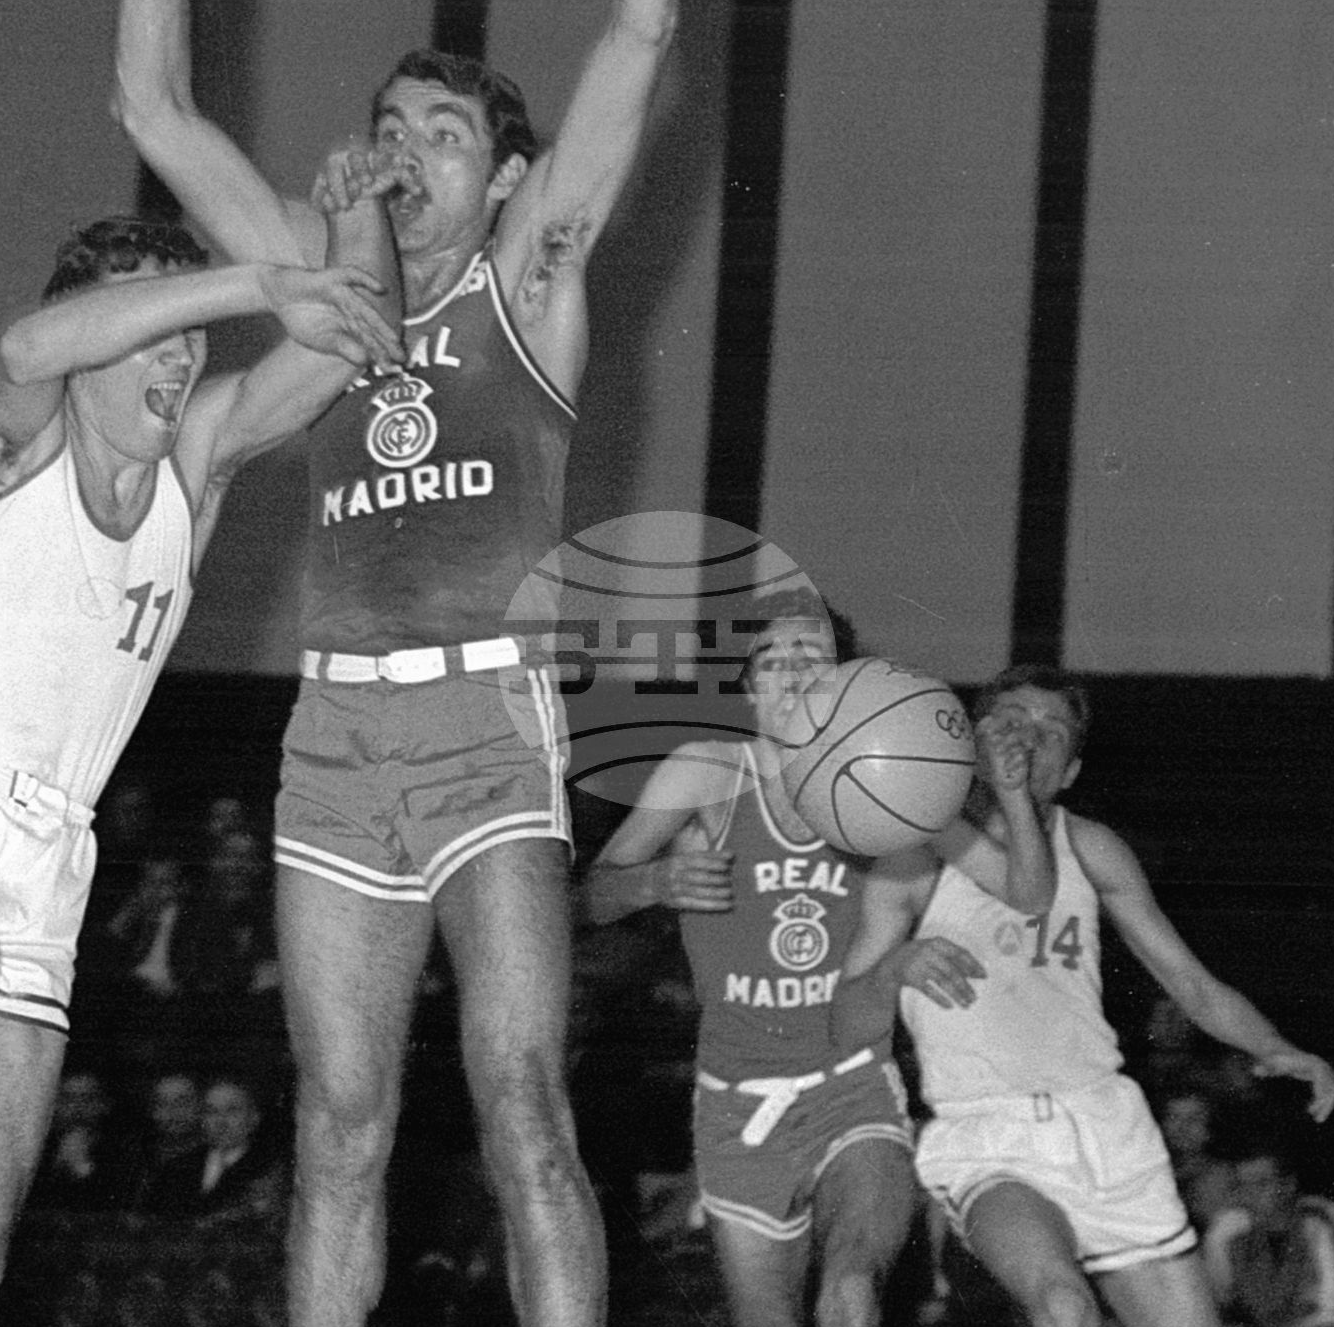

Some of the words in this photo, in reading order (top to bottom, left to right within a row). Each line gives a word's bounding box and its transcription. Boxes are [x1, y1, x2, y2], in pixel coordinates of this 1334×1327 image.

[323, 460, 494, 527] MADRID
[116, 581, 174, 662] 11
[754, 858, 849, 897] REAL
[1026, 915, 1083, 970] 14
